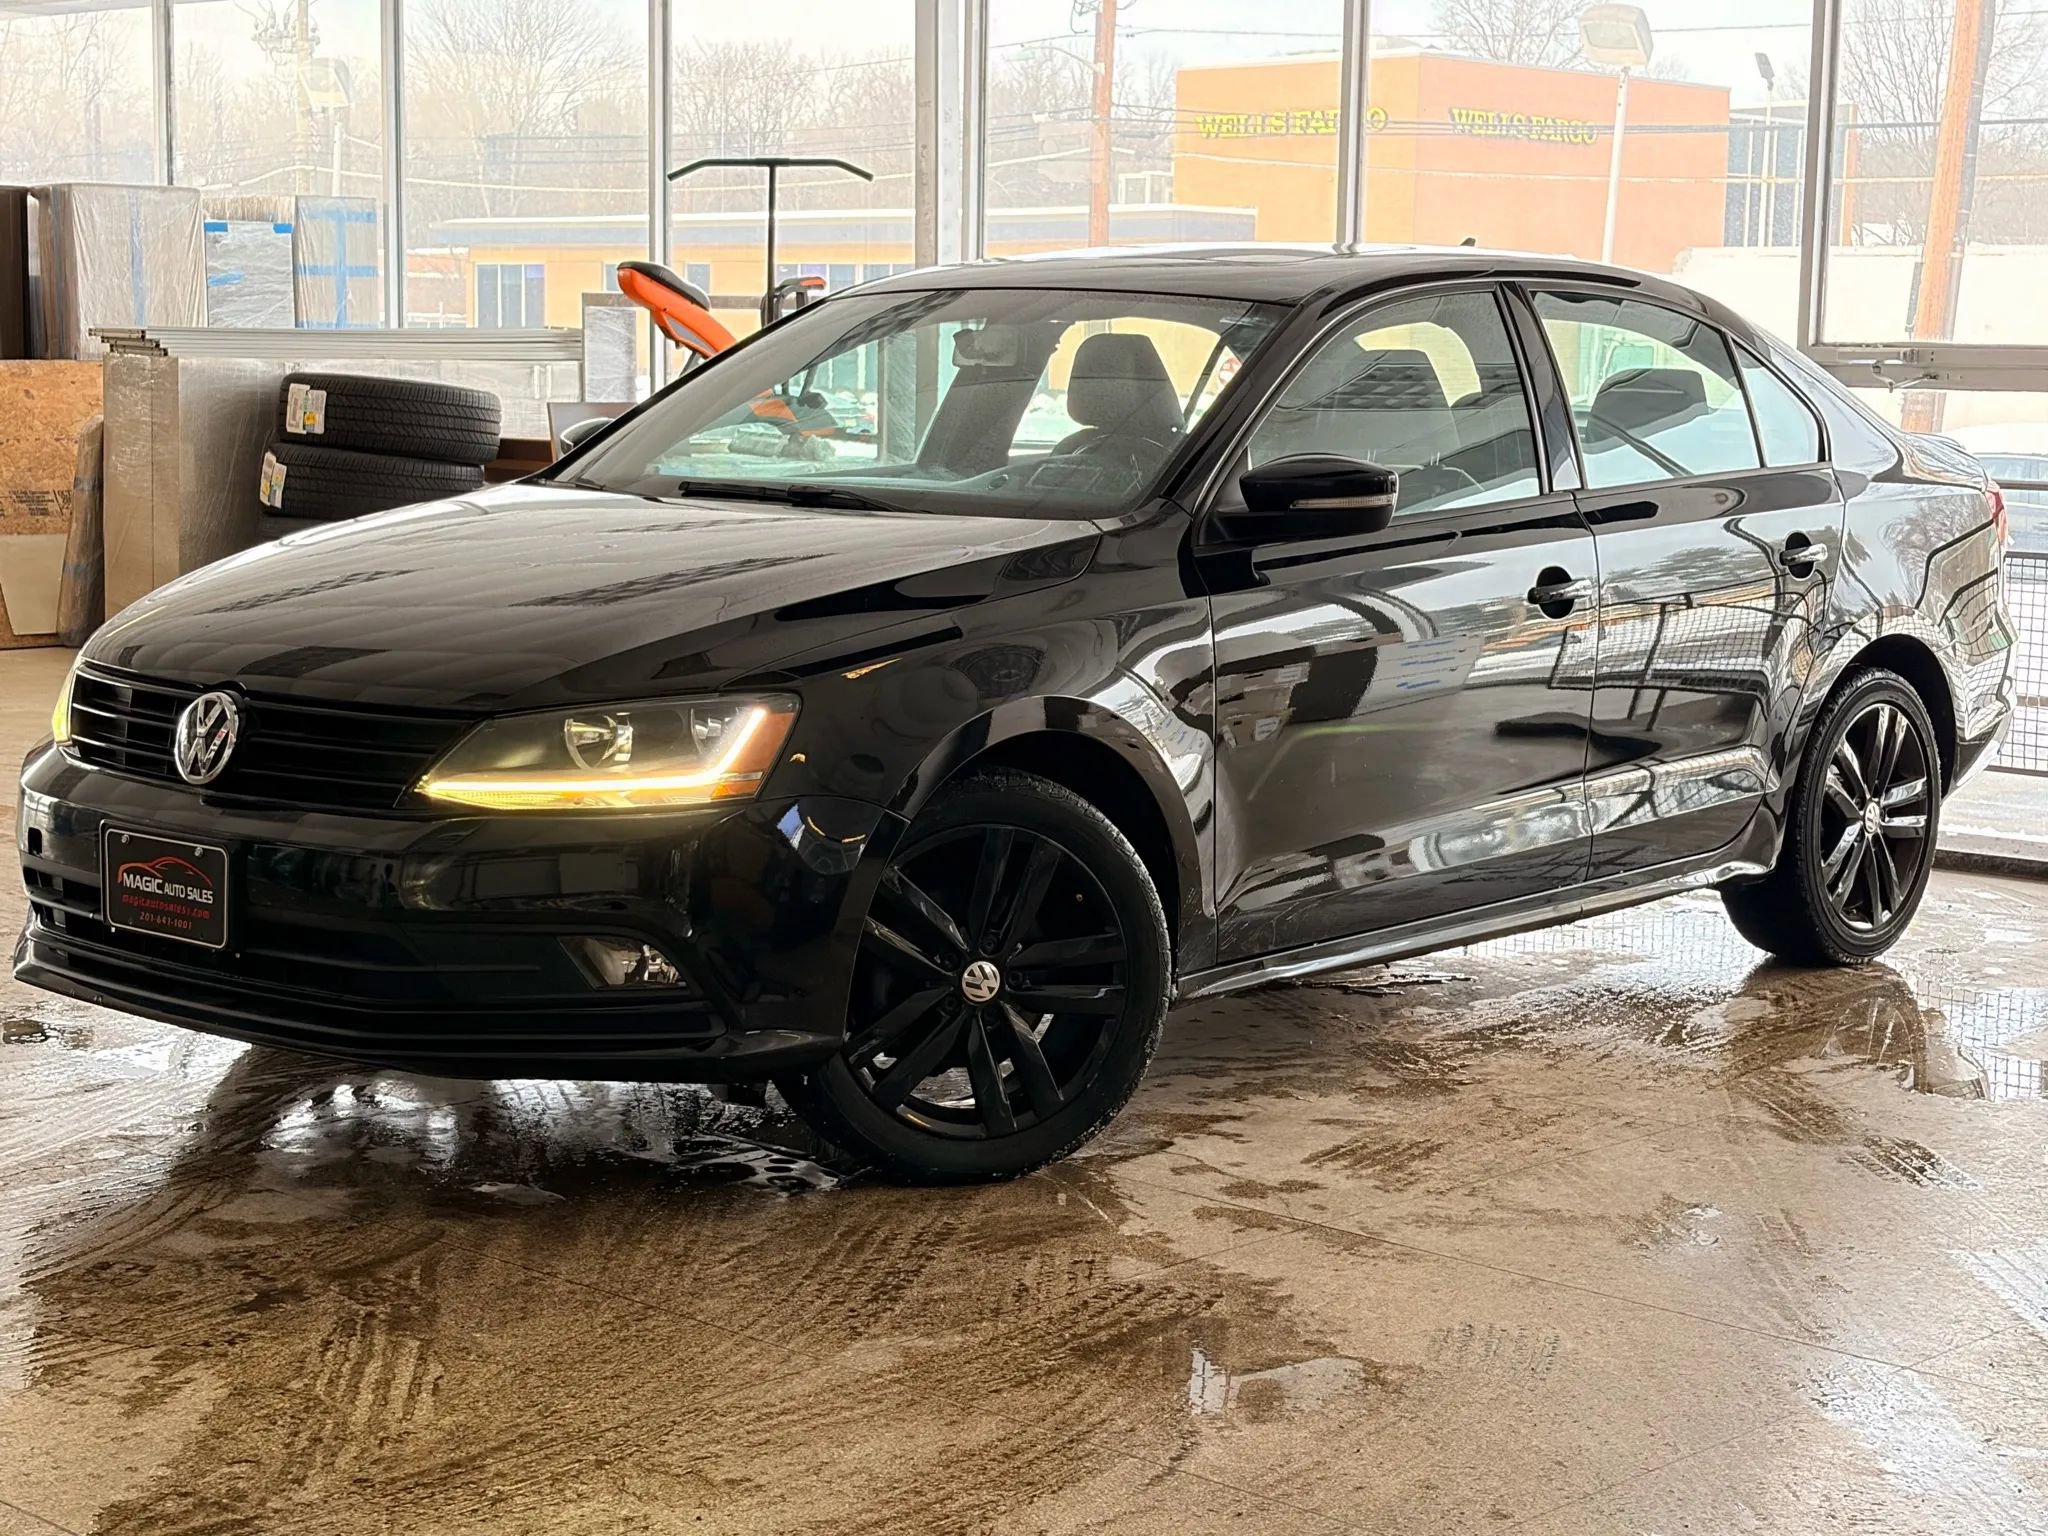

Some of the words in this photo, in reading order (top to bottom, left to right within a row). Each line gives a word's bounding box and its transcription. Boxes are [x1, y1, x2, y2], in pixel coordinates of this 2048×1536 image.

[1195, 111, 1289, 139] WELLS
[1449, 107, 1527, 138] WELLS
[1528, 115, 1599, 145] FARGO
[123, 872, 164, 895] MAGIC
[164, 882, 186, 899] AUTO
[187, 887, 214, 904] SALES
